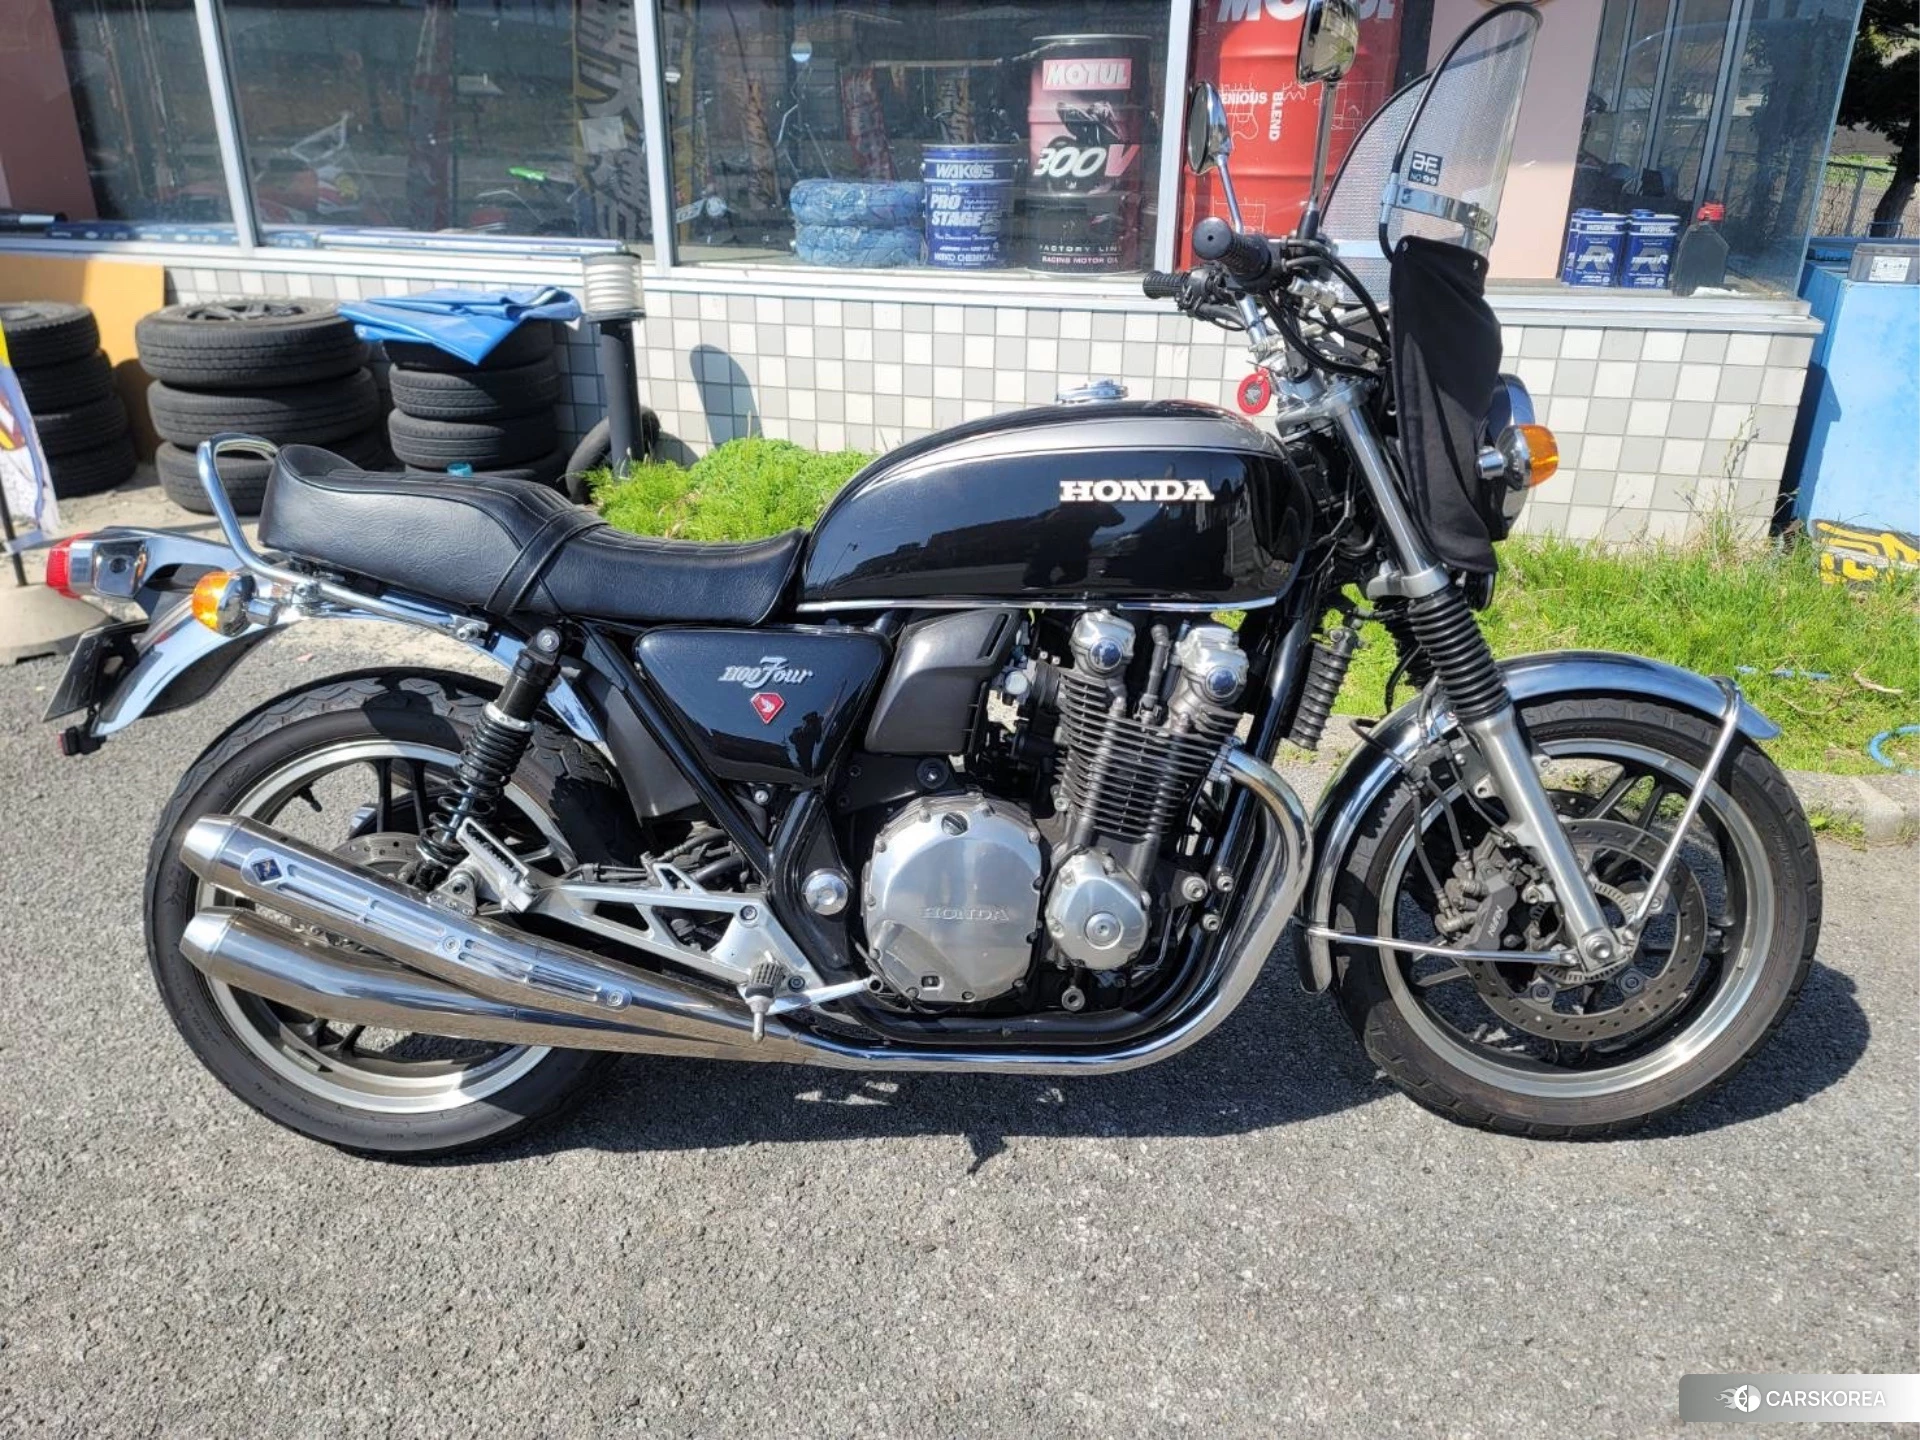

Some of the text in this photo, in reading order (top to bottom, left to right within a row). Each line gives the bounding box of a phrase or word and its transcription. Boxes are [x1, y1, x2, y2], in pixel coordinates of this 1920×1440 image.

[1045, 63, 1127, 85] MOTUL
[1221, 91, 1267, 105] ENIOUS
[1268, 91, 1285, 141] BLEND
[1032, 143, 1140, 178] 300V
[930, 194, 961, 209] PRO
[931, 211, 984, 227] STAGE
[1073, 256, 1105, 264] MOTOR
[1059, 479, 1215, 502] HONDA
[921, 907, 1010, 921] HONDA
